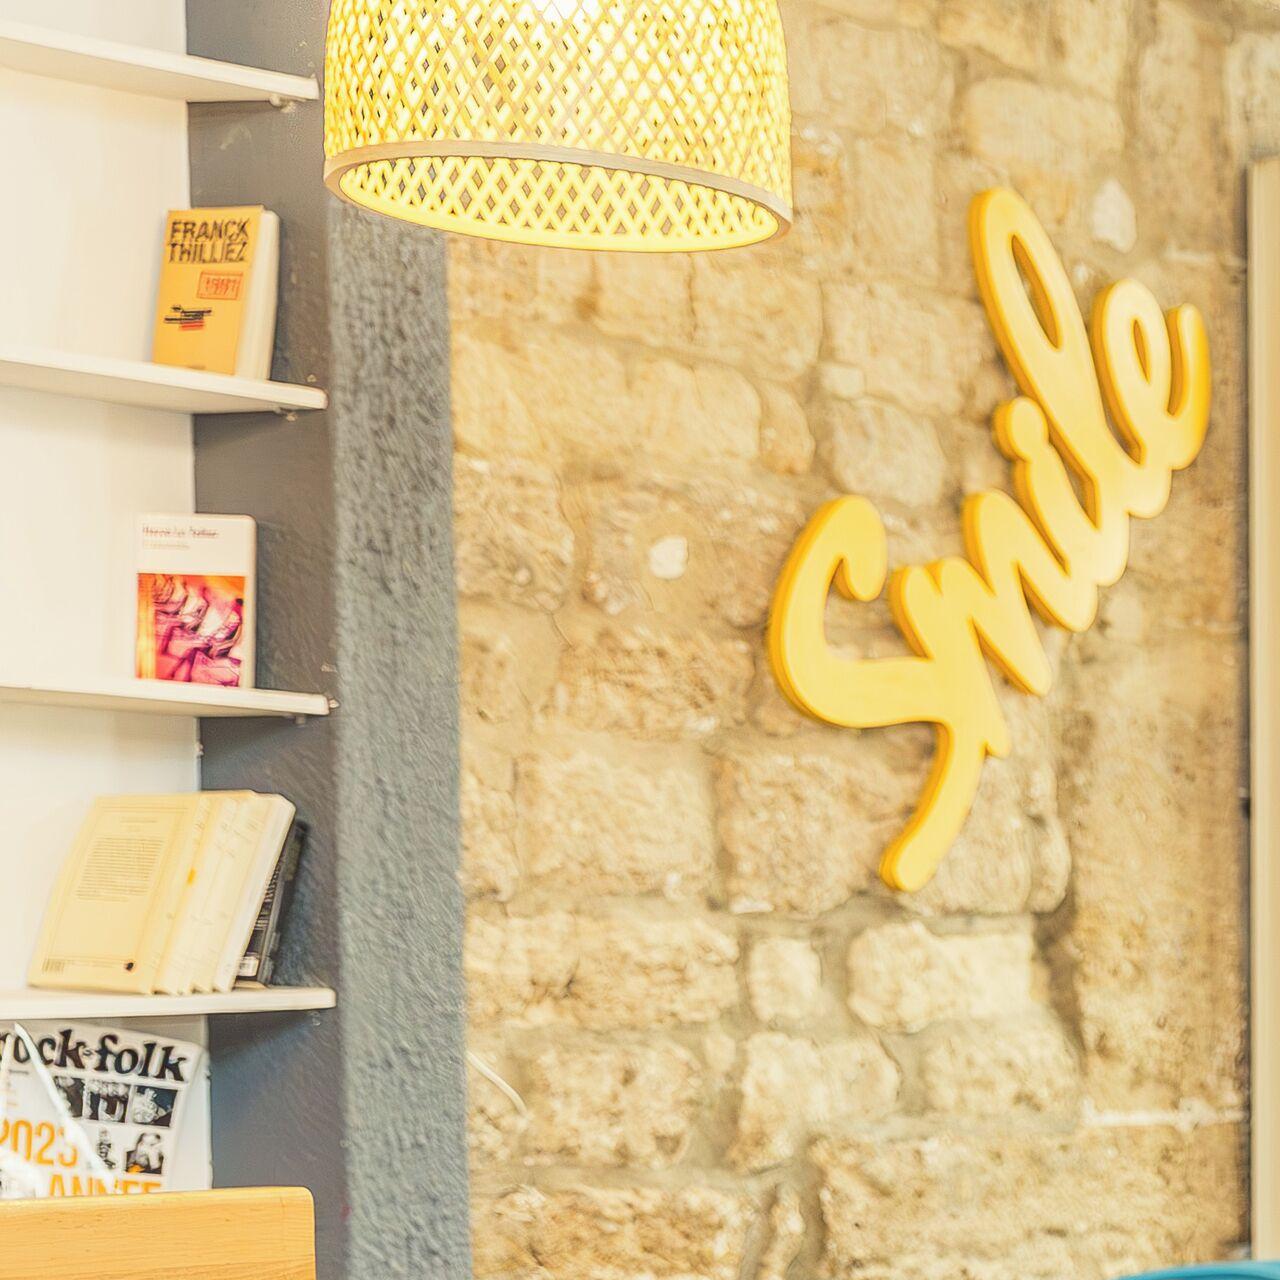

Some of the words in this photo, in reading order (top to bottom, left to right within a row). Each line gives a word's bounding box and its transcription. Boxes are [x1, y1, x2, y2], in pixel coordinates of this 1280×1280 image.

[170, 218, 249, 241] FRANCK
[168, 242, 247, 263] THILLIEZ
[767, 187, 1212, 892] Smile
